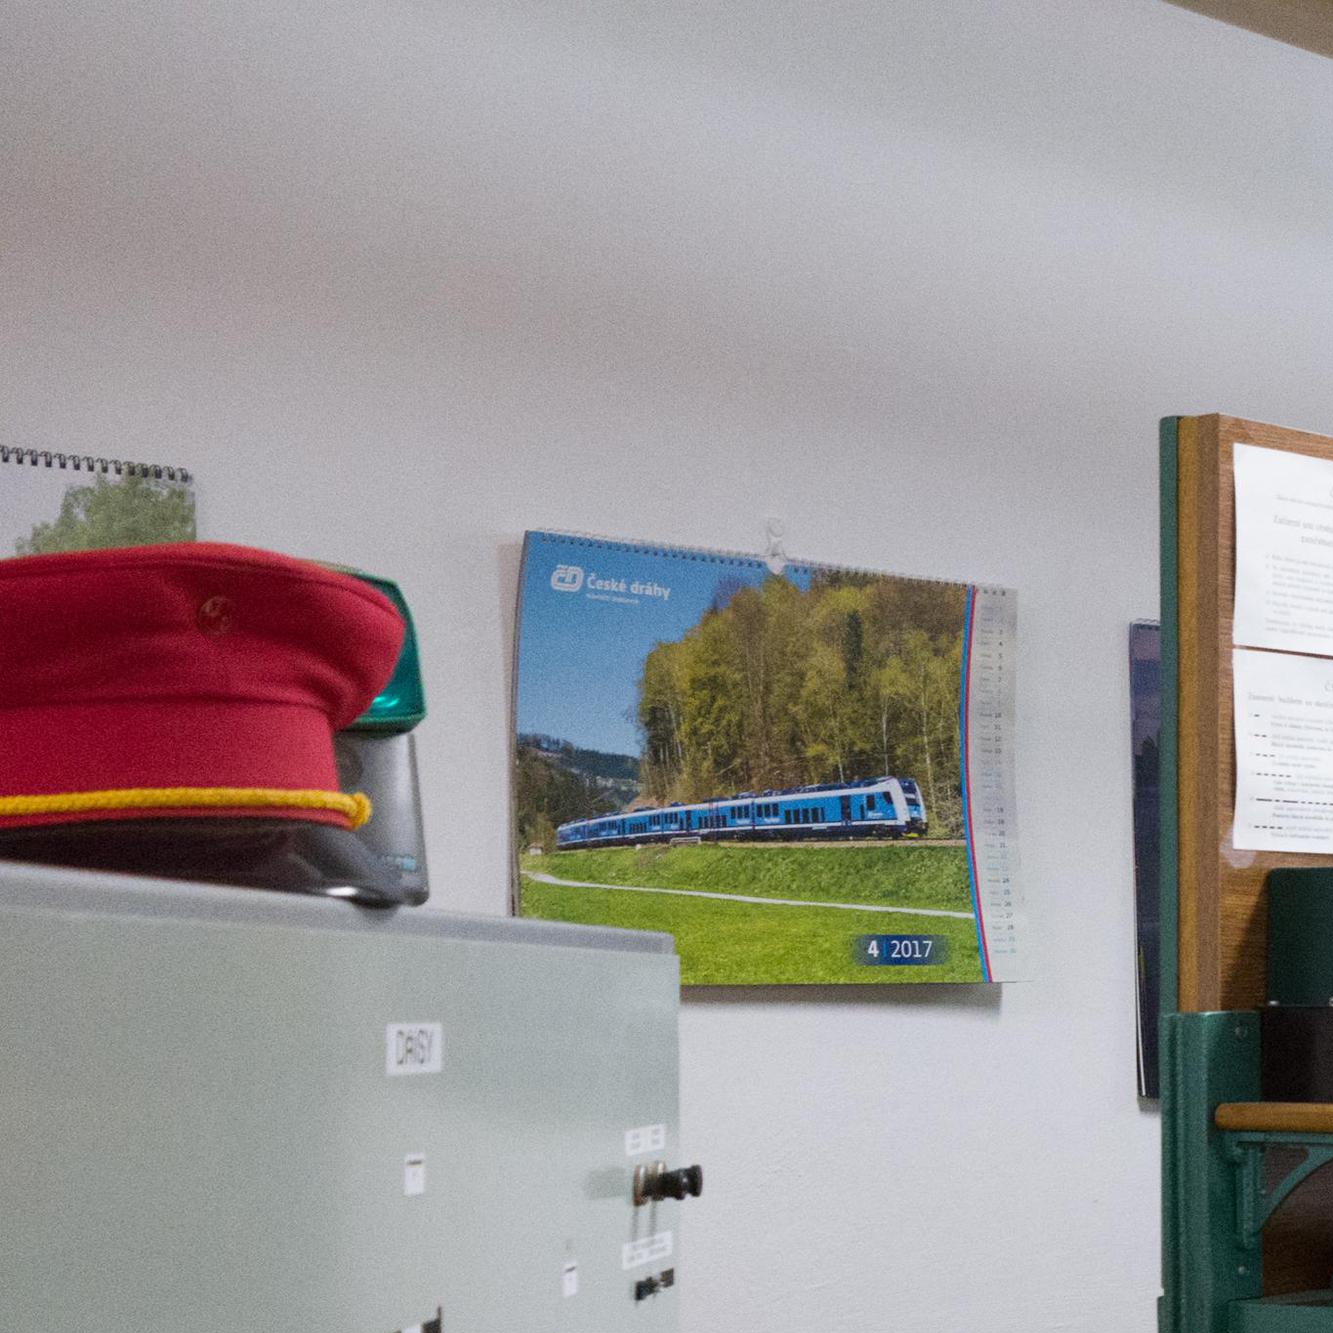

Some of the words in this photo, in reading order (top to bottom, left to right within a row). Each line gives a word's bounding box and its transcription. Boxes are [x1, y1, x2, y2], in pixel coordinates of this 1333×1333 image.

[587, 572, 627, 593] České
[630, 580, 671, 601] dráhy
[867, 939, 880, 958] 4
[890, 939, 933, 958] 2017
